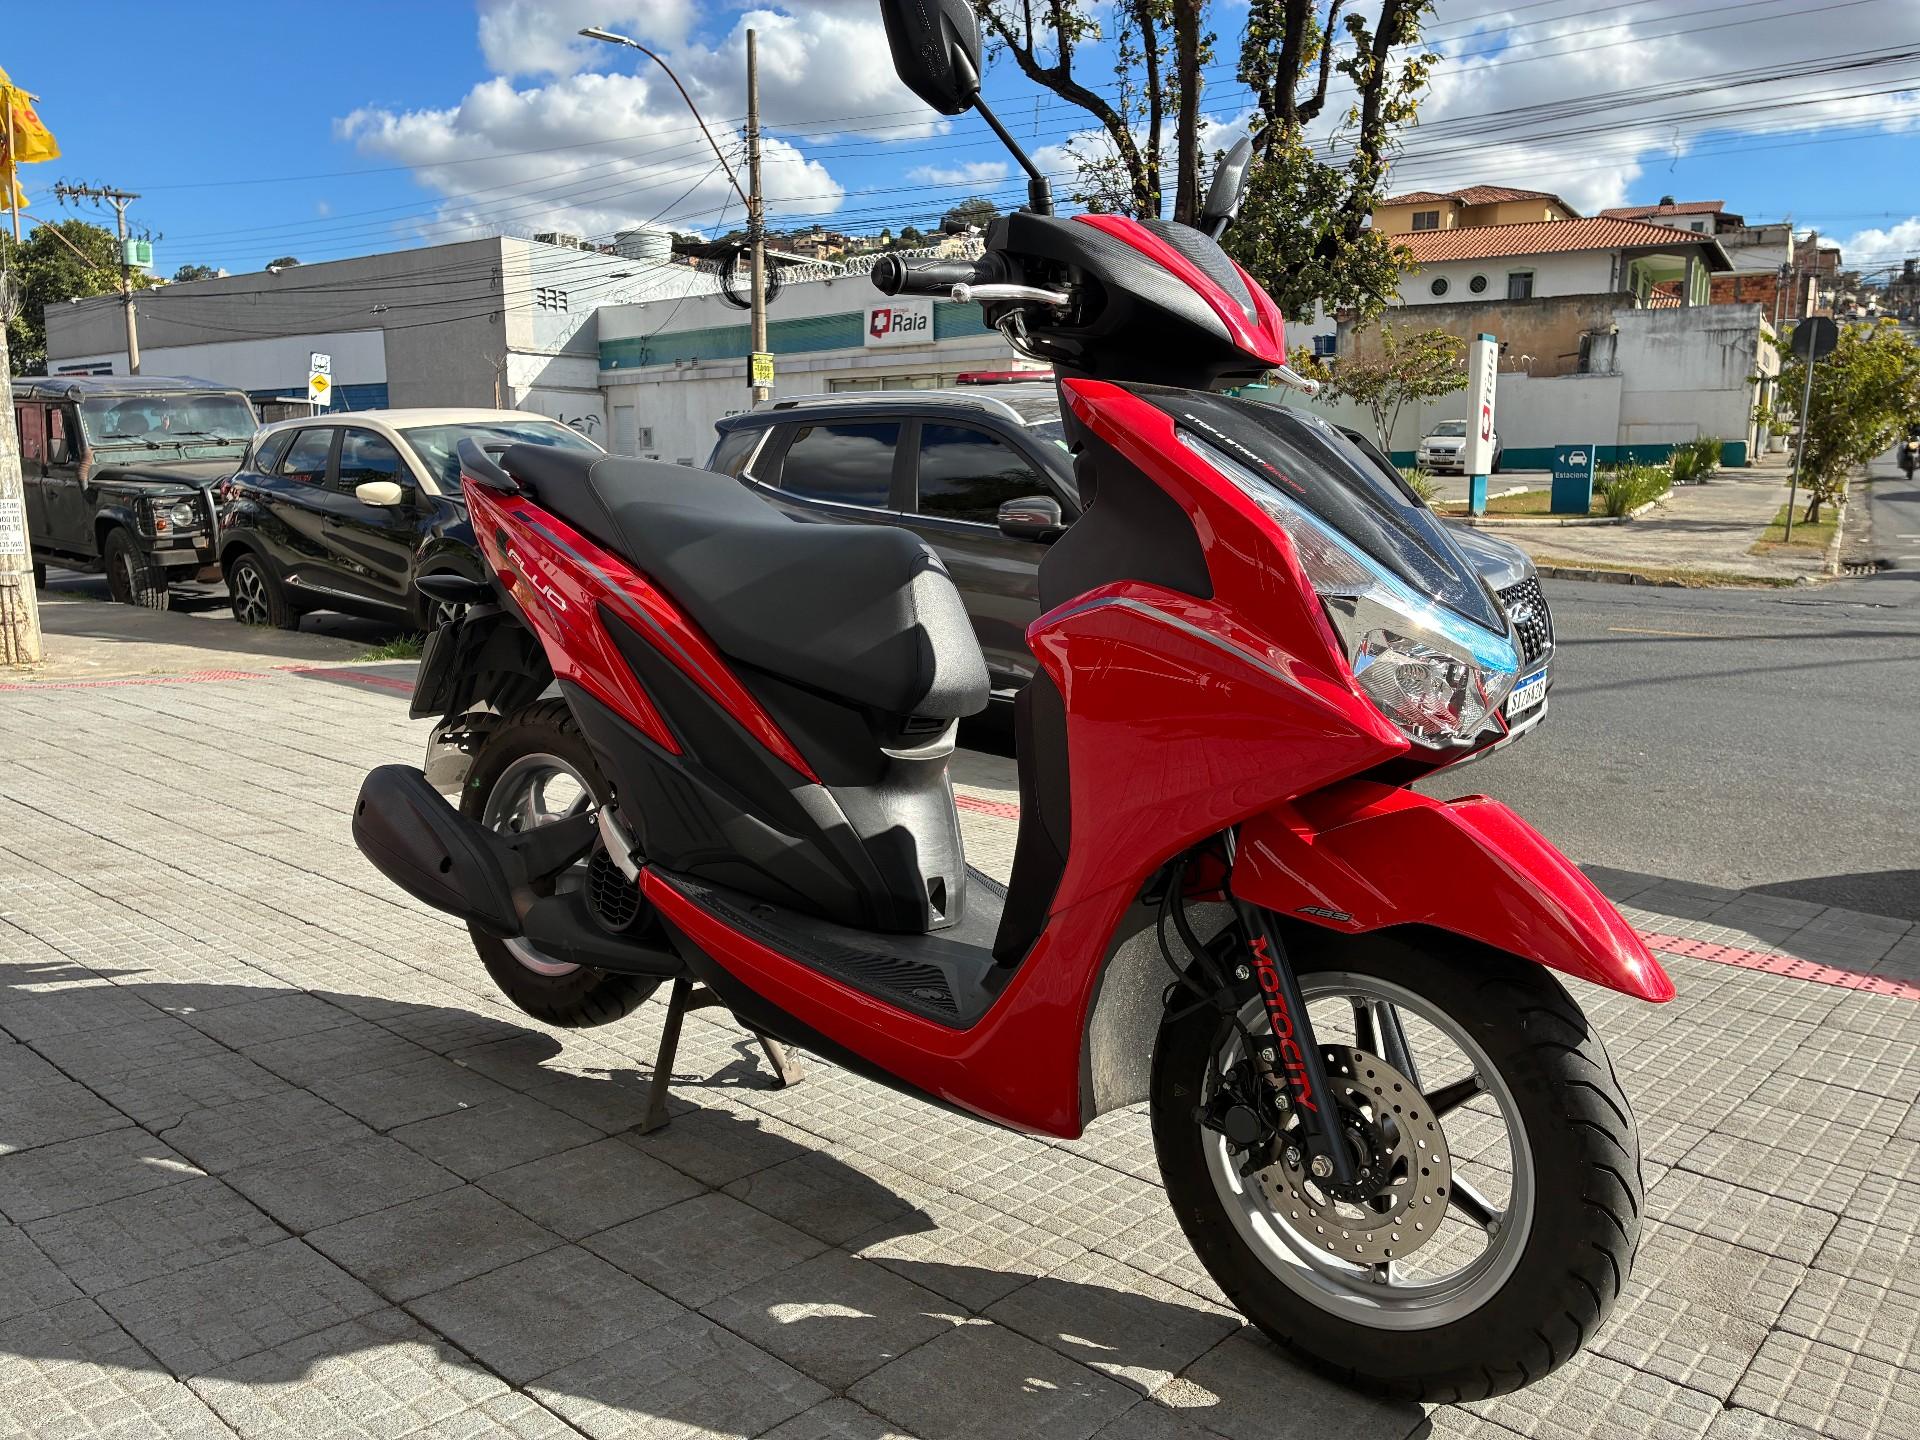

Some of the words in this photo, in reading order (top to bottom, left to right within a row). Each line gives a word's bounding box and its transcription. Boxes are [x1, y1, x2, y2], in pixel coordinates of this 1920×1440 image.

[892, 313, 927, 332] Raia
[1555, 471, 1589, 479] Estacione
[507, 548, 567, 611] FLUO
[1296, 906, 1351, 921] ABS
[1248, 934, 1318, 1113] MOTOCITY
